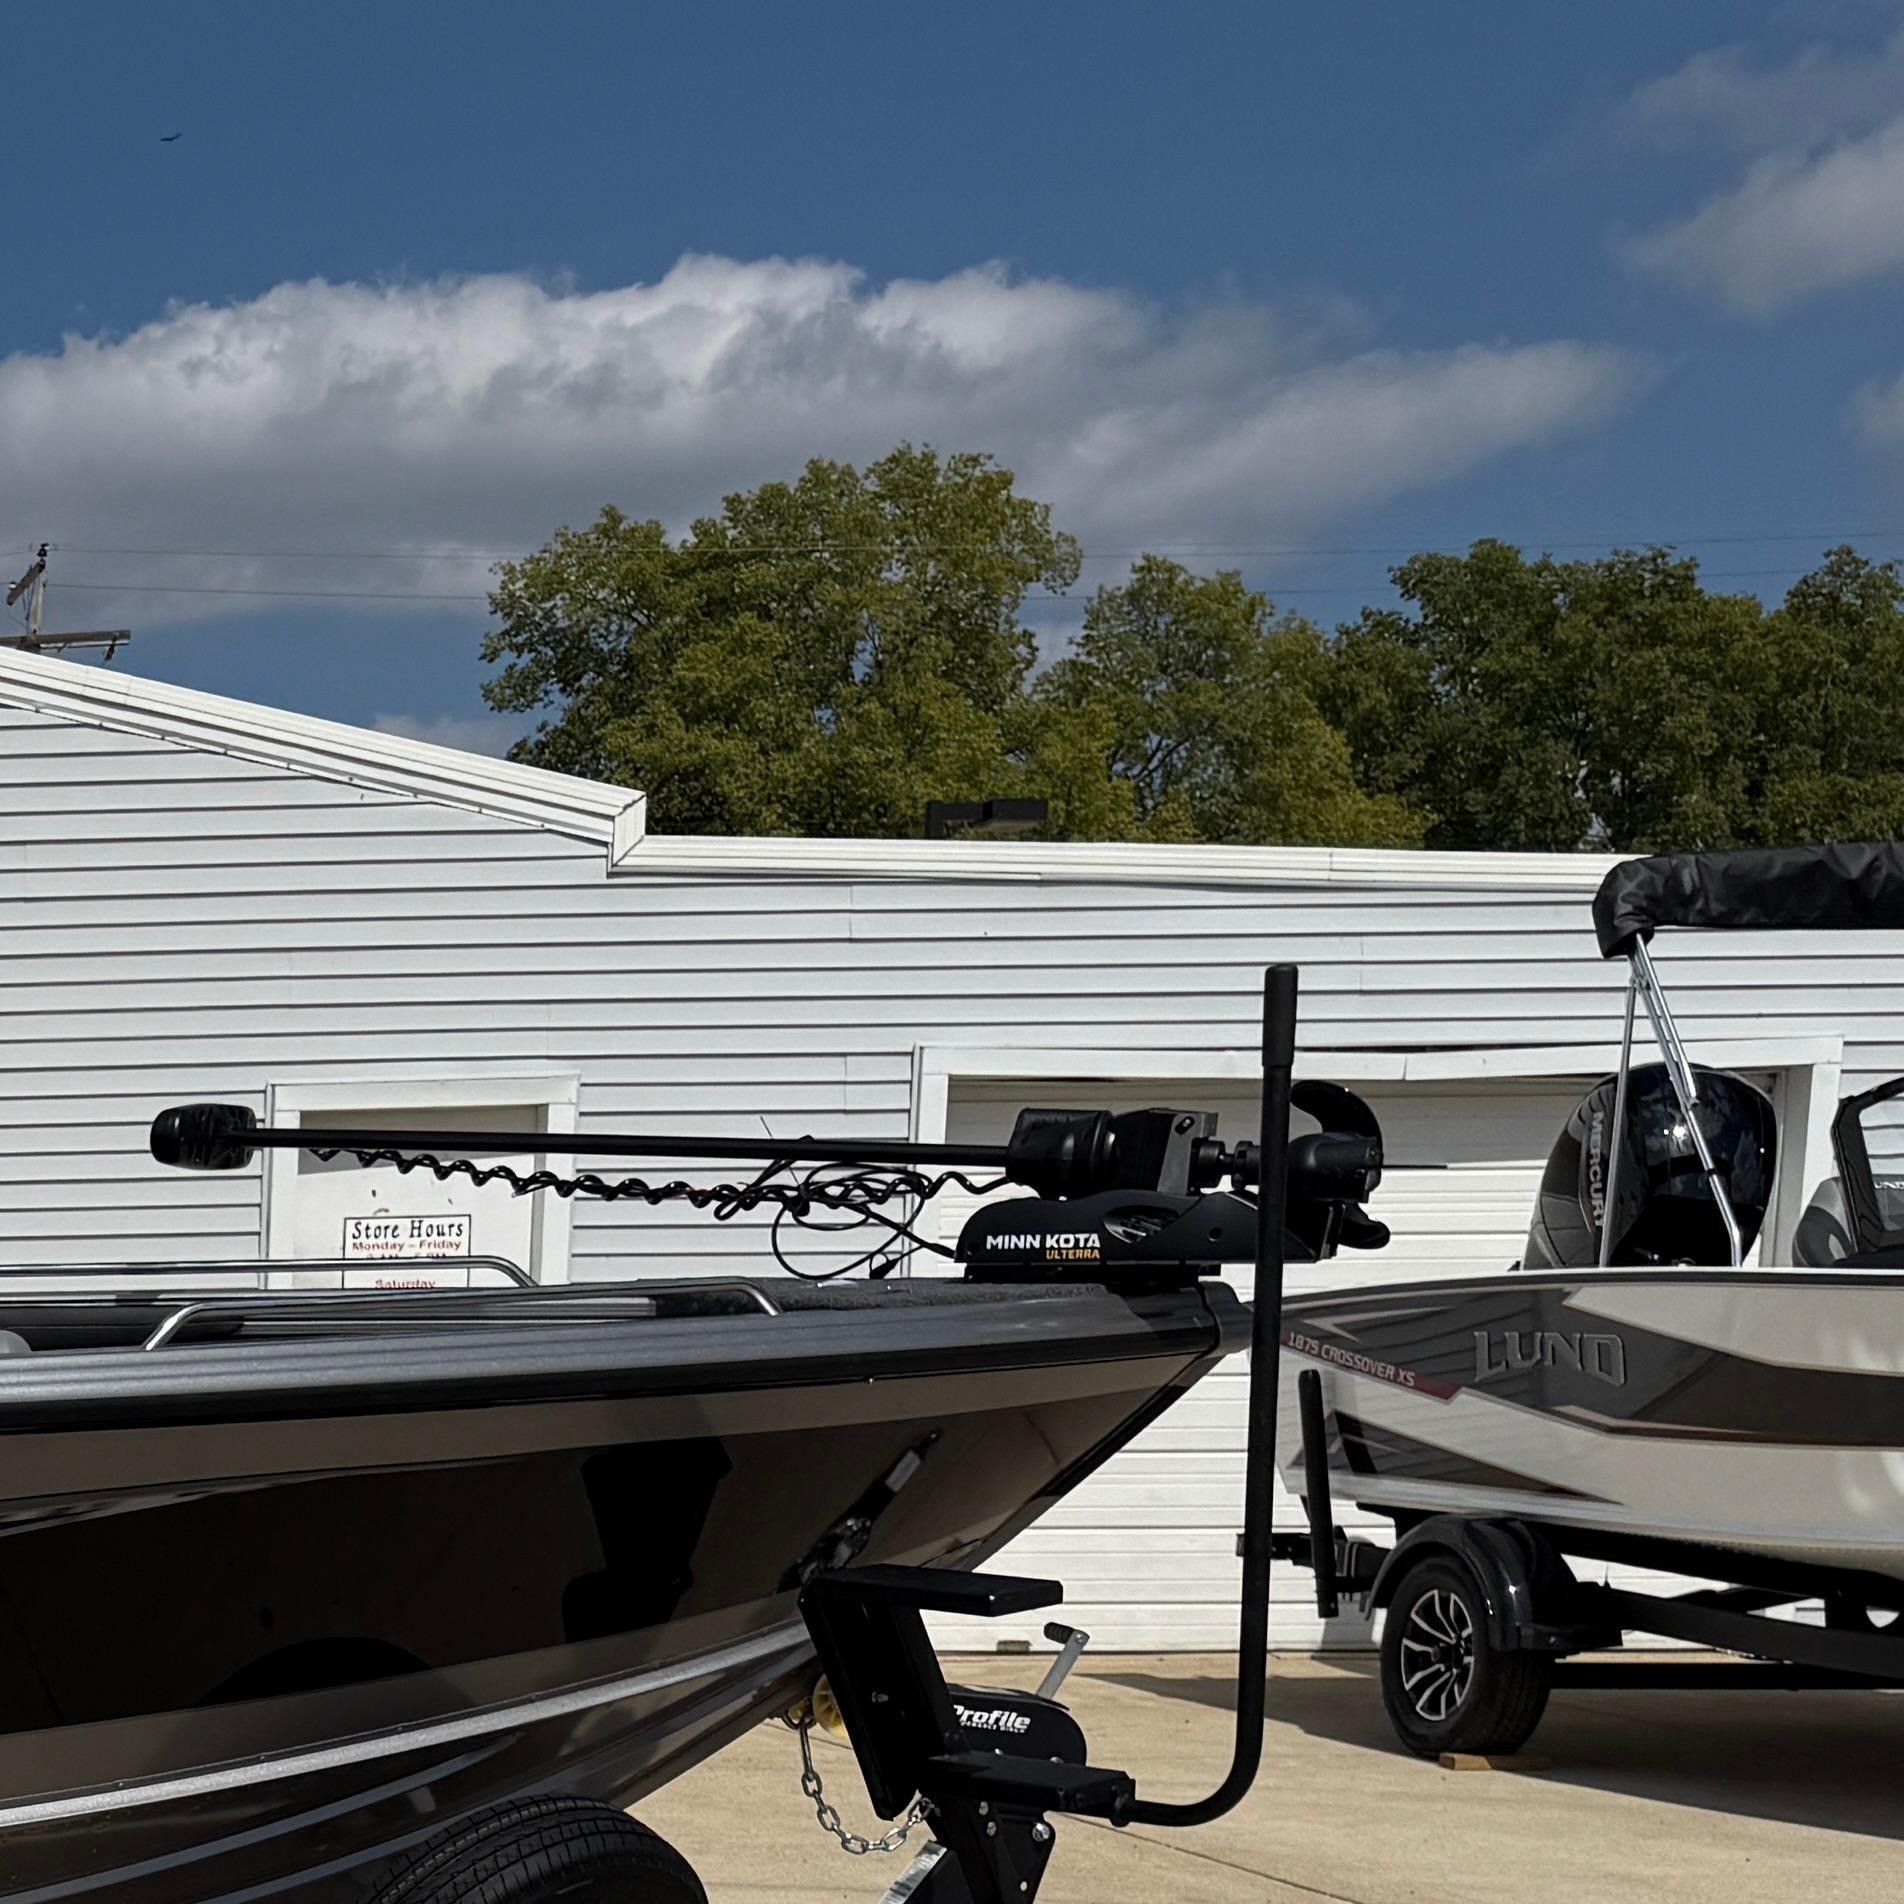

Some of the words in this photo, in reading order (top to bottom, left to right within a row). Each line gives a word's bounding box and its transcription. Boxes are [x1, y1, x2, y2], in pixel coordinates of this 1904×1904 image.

[352, 1221, 400, 1239] Store
[409, 1219, 463, 1238] Hours
[352, 1241, 405, 1251] Monday
[419, 1240, 461, 1251] Friday
[986, 1234, 1041, 1249] MINN
[1045, 1233, 1101, 1248] KOTA
[1046, 1249, 1100, 1259] ULTERRA
[1288, 1332, 1320, 1354] 1875
[1321, 1345, 1395, 1380] CROSSOVER
[1397, 1368, 1416, 1387] XS
[1473, 1331, 1627, 1387] LUND
